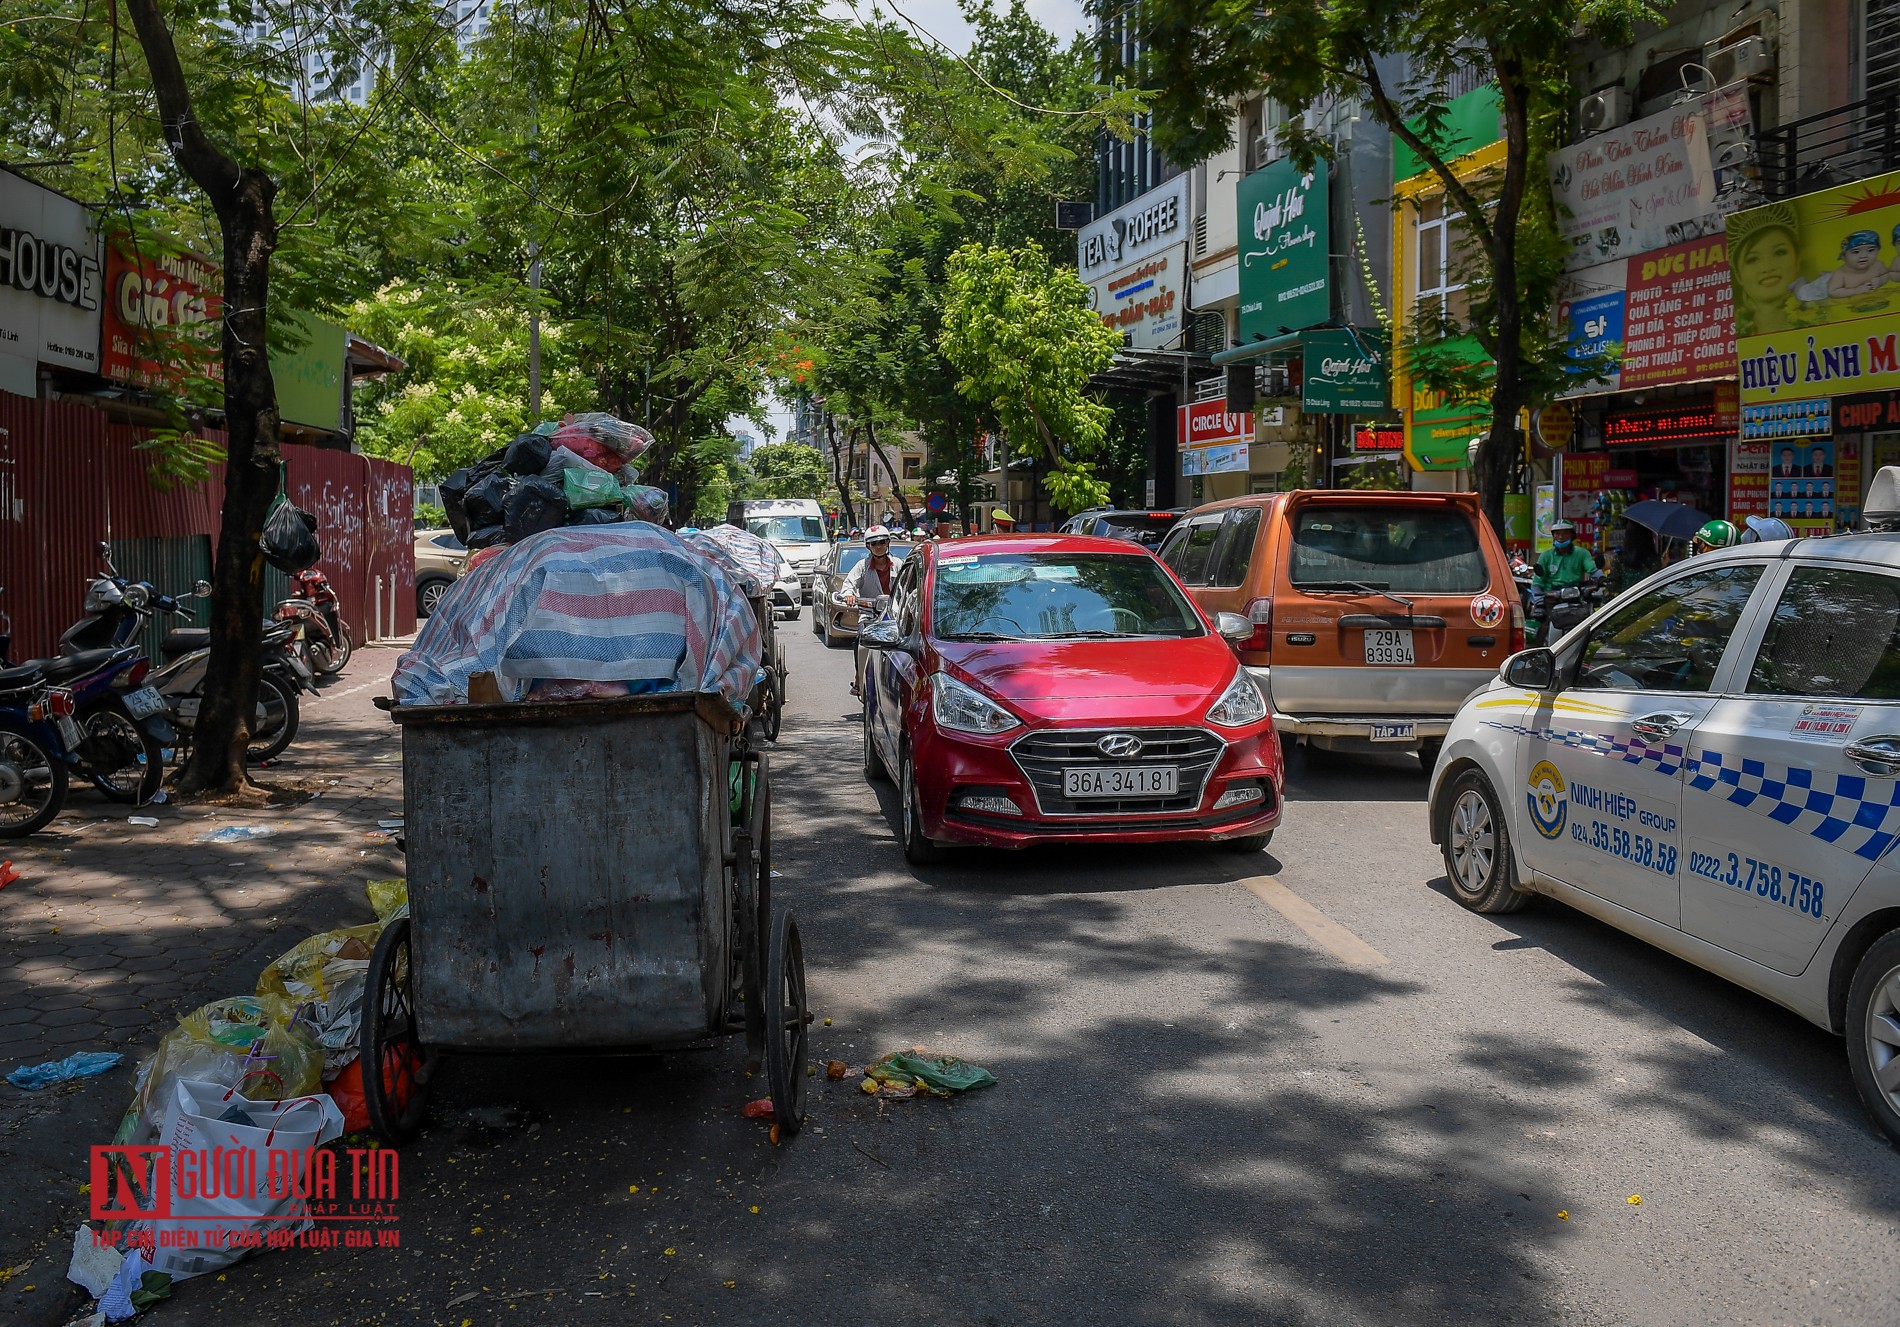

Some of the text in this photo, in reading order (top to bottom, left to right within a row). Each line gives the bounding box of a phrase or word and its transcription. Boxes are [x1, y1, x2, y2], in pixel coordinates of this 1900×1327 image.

[1081, 195, 1178, 270] TEA COFFEE
[1642, 254, 1685, 281] ĐỨC
[1629, 303, 1650, 321] QUÀ
[1653, 298, 1681, 316] TẶNG
[1693, 294, 1705, 307] IN
[1628, 322, 1645, 336] GHI
[1647, 318, 1664, 333] ĐĨA
[1674, 311, 1703, 328] SCAN
[1627, 337, 1655, 353] PHONG
[1656, 333, 1665, 347] BÌ
[1673, 329, 1698, 346] THIỆP
[1652, 348, 1684, 366] THUẬT
[1694, 342, 1725, 359] CÔNG
[1741, 334, 1900, 395] HIỆU ẢNH M
[1192, 412, 1221, 432] CIRCLE
[1839, 402, 1882, 430] CHỤP
[1291, 634, 1312, 643] ISUZU
[1376, 630, 1401, 646] 29A
[1366, 648, 1413, 664] 839.94
[1069, 771, 1172, 793] 36A-341.81
[1571, 782, 1676, 833] NINH HIỆP GROUP
[1689, 851, 1824, 919] 0222.3.758.758
